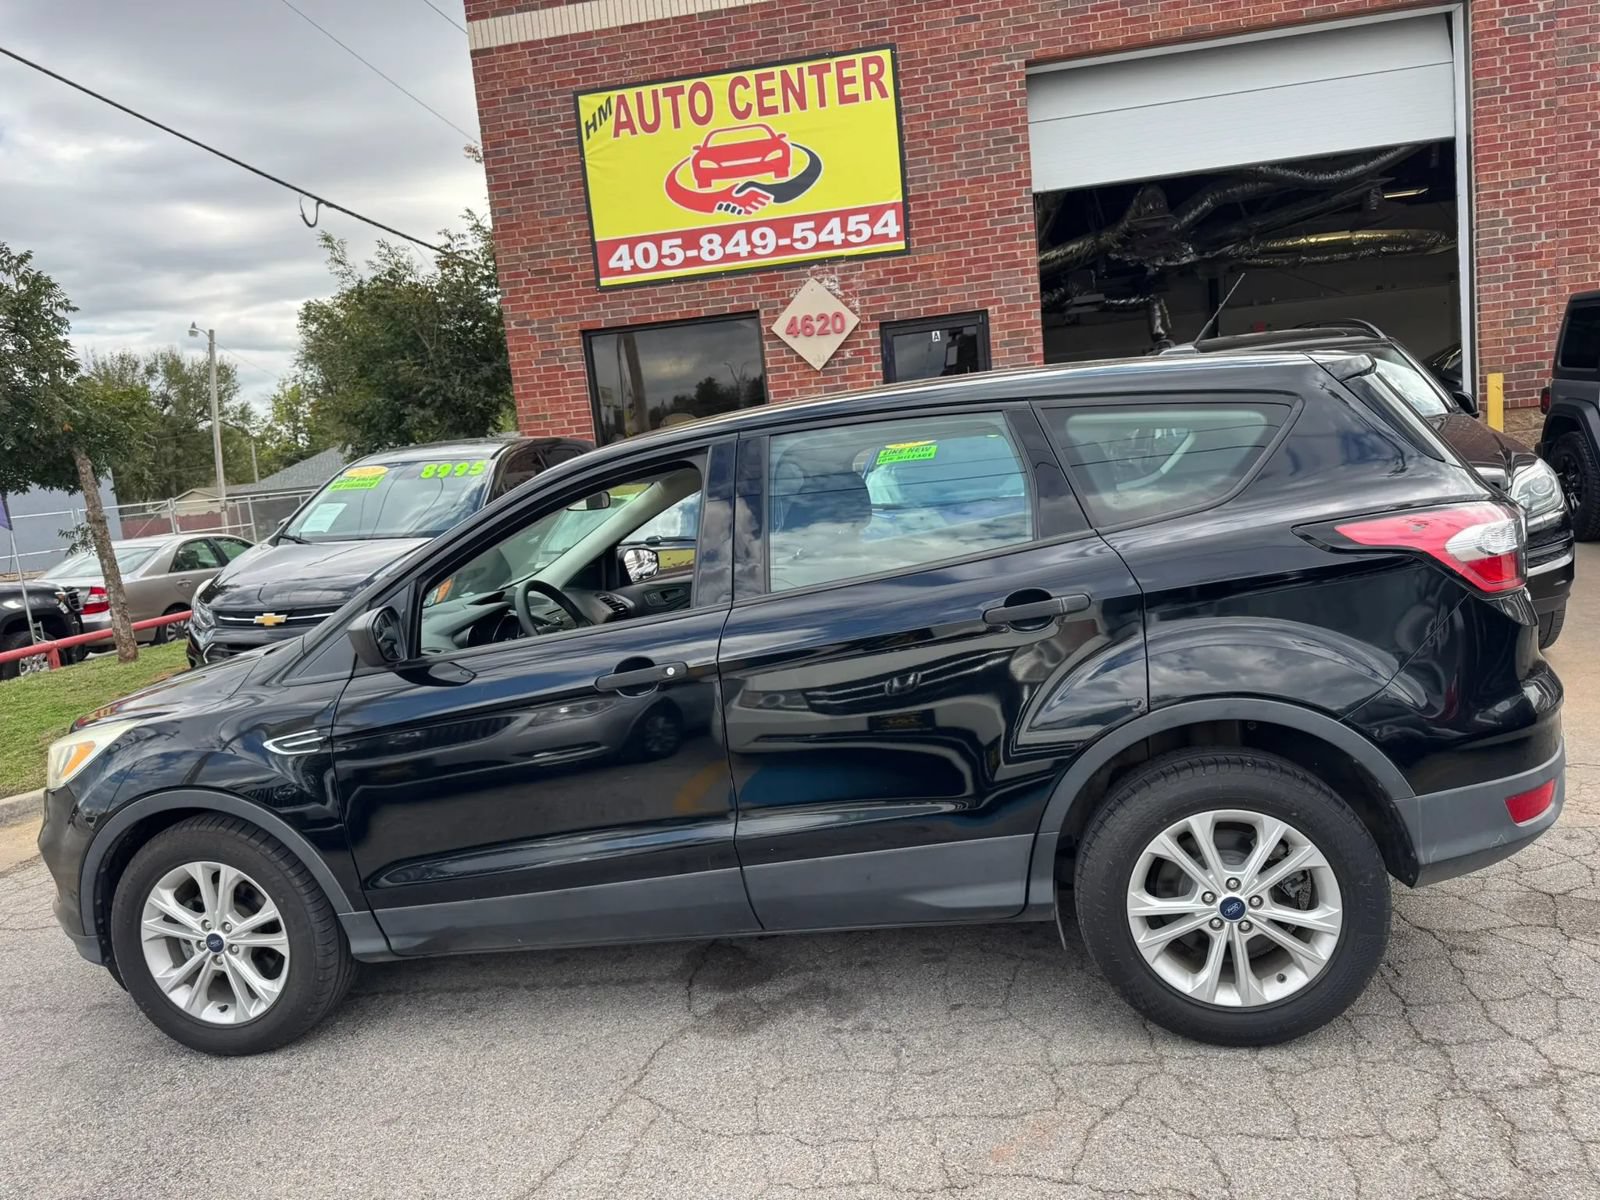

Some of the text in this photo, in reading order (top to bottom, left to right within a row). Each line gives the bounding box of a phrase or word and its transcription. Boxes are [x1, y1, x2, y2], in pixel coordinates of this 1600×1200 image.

[585, 55, 889, 140] HM AUTO CENTER
[607, 210, 900, 272] 405-849-5454
[785, 311, 845, 338] 4620
[420, 461, 486, 479] 8995
